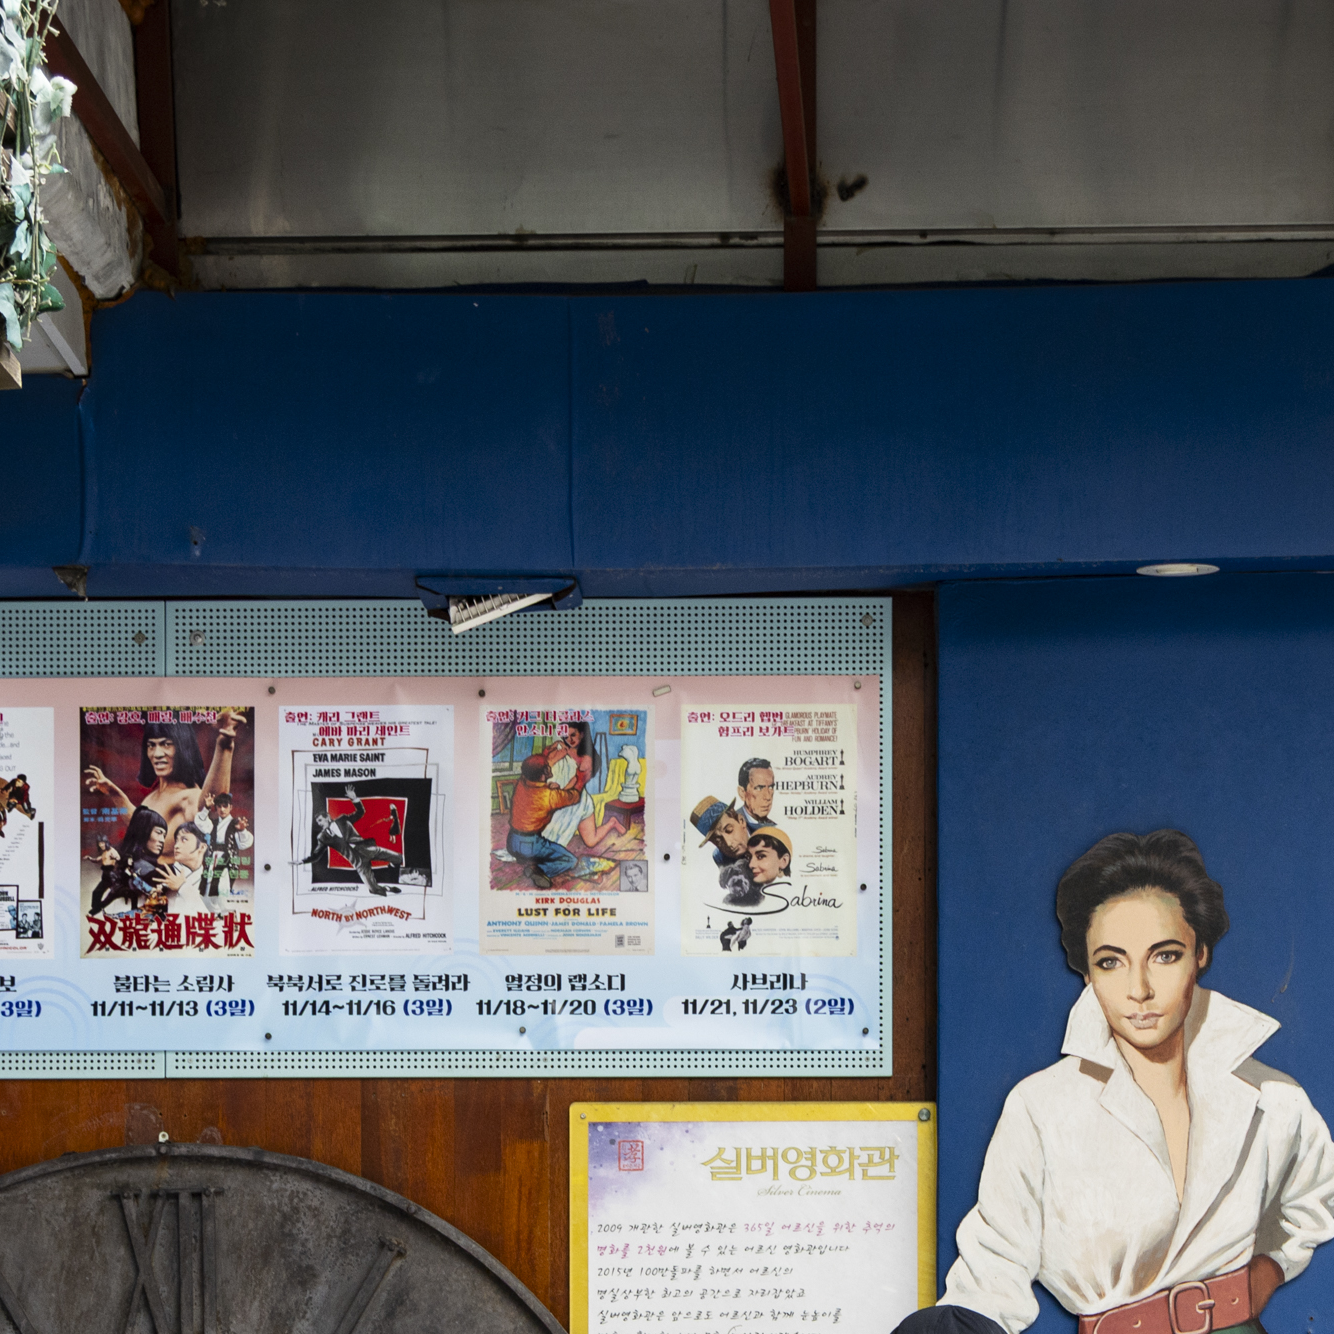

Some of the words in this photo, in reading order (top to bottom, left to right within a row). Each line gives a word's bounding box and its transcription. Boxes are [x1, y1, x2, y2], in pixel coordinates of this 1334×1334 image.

[687, 711, 715, 723] 출연:
[719, 711, 756, 723] 오드리
[759, 711, 784, 723] 헵번
[718, 726, 755, 737] 험프리
[758, 726, 795, 737] 보가트
[312, 737, 339, 747] CARY
[347, 737, 385, 747] GRANT
[312, 753, 329, 763] EVA
[331, 753, 355, 763] MARIE
[357, 753, 385, 763] SAINT
[784, 757, 838, 766] BOGART
[312, 768, 342, 778] JAMES
[343, 768, 377, 778] MASON
[775, 780, 838, 790] HEPBURN
[784, 806, 838, 815] HOLDEN
[310, 908, 343, 922] NORTH
[343, 913, 355, 923] BY
[355, 905, 412, 922] NORTHWEST
[517, 908, 549, 918] LUST
[554, 908, 581, 918] FOR
[586, 908, 617, 918] LIFE
[113, 974, 171, 993] 불타는
[176, 974, 235, 993] 소림사
[266, 973, 344, 993] 북북서로
[348, 973, 407, 993] 진로를
[411, 973, 471, 993] 돌려라
[504, 973, 563, 993] 열정의
[567, 973, 626, 993] 랩소디
[730, 972, 809, 991] 사브리나
[90, 1000, 199, 1017] 11/11~11/13
[205, 998, 256, 1018] (3일)
[281, 999, 396, 1016] 11/14~11/16
[402, 997, 453, 1016] (3일)
[475, 998, 596, 1016] 11/18~11/20
[603, 997, 654, 1016] (3일)
[681, 998, 737, 1017] 11/21,
[741, 998, 798, 1015] 11/23
[804, 997, 855, 1015] (2일)
[701, 1145, 901, 1183] 실버영화관
[757, 1186, 795, 1197] Silver
[797, 1184, 842, 1197] Cinema
[597, 1223, 623, 1234] 2009
[669, 1221, 737, 1236] 실버영화관은
[743, 1221, 776, 1235] 365일
